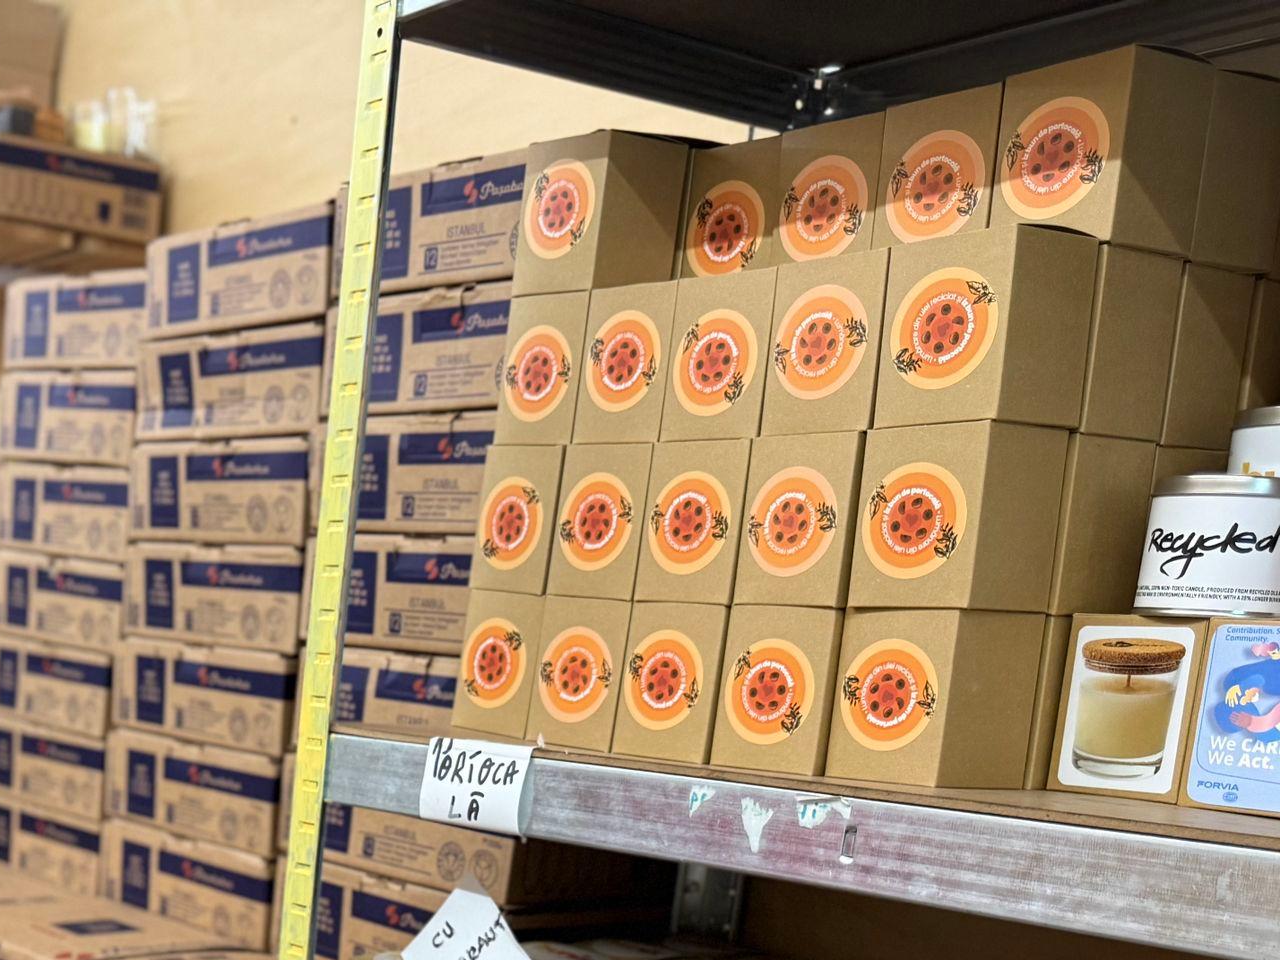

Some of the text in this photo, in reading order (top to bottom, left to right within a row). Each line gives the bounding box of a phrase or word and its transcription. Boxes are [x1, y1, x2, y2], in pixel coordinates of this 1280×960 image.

[1148, 522, 1280, 579] Recycled
[1227, 627, 1275, 635] Contribution.
[1211, 736, 1280, 754] We CAR
[1208, 750, 1274, 769] We Act.
[1197, 781, 1239, 791] FORVIA
[432, 920, 455, 948] CU
